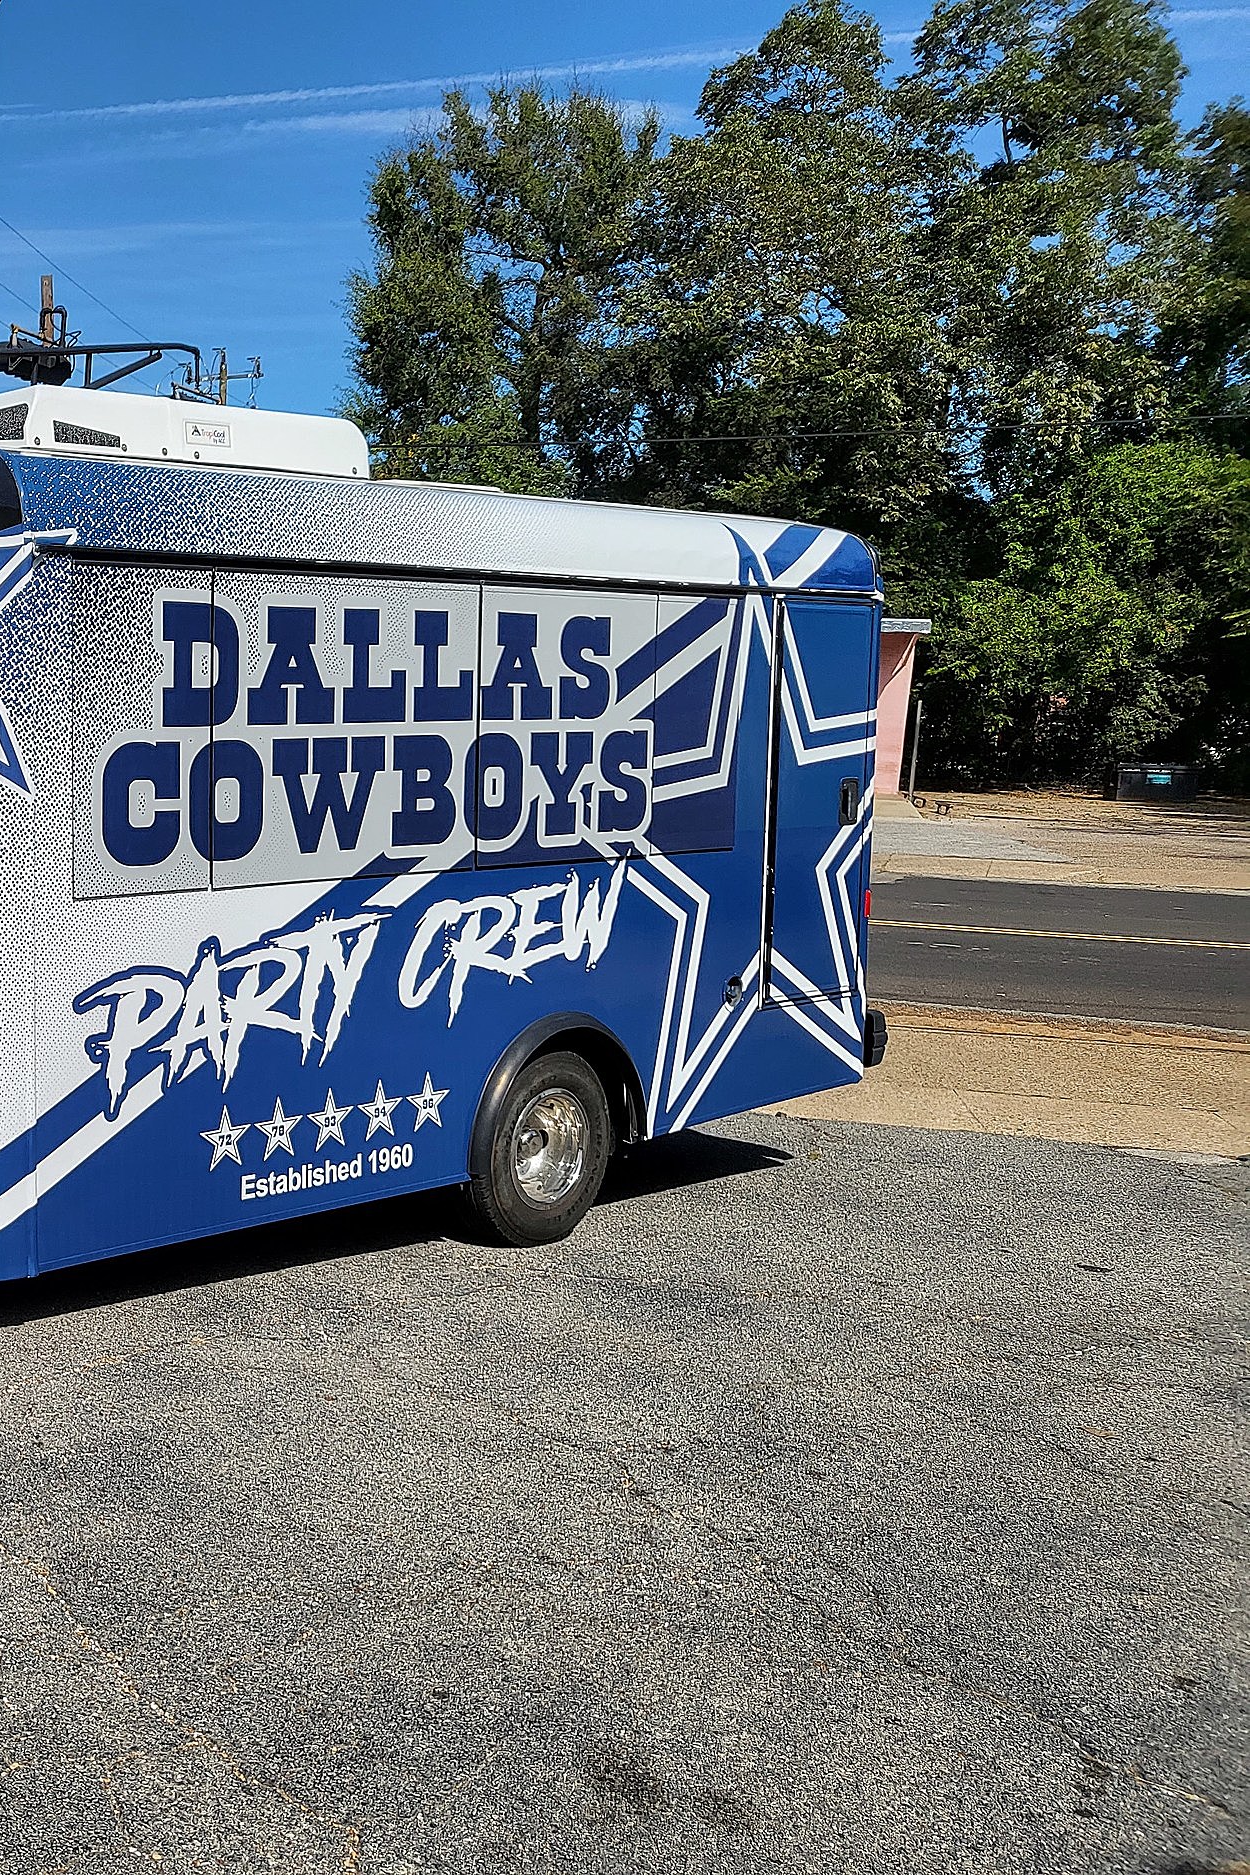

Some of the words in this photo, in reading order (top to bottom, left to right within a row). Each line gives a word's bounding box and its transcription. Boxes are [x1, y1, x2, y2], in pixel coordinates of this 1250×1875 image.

[161, 600, 612, 728] DALLAS
[101, 730, 649, 867] COWBOYS
[78, 908, 393, 1113] PARTY
[398, 848, 632, 1028] CREW
[218, 1133, 232, 1147] 72
[271, 1125, 285, 1138] 78
[324, 1115, 337, 1128] 93
[374, 1105, 387, 1118] 94
[422, 1098, 434, 1109] 96
[241, 1153, 363, 1201] Established
[368, 1143, 414, 1174] 1960
